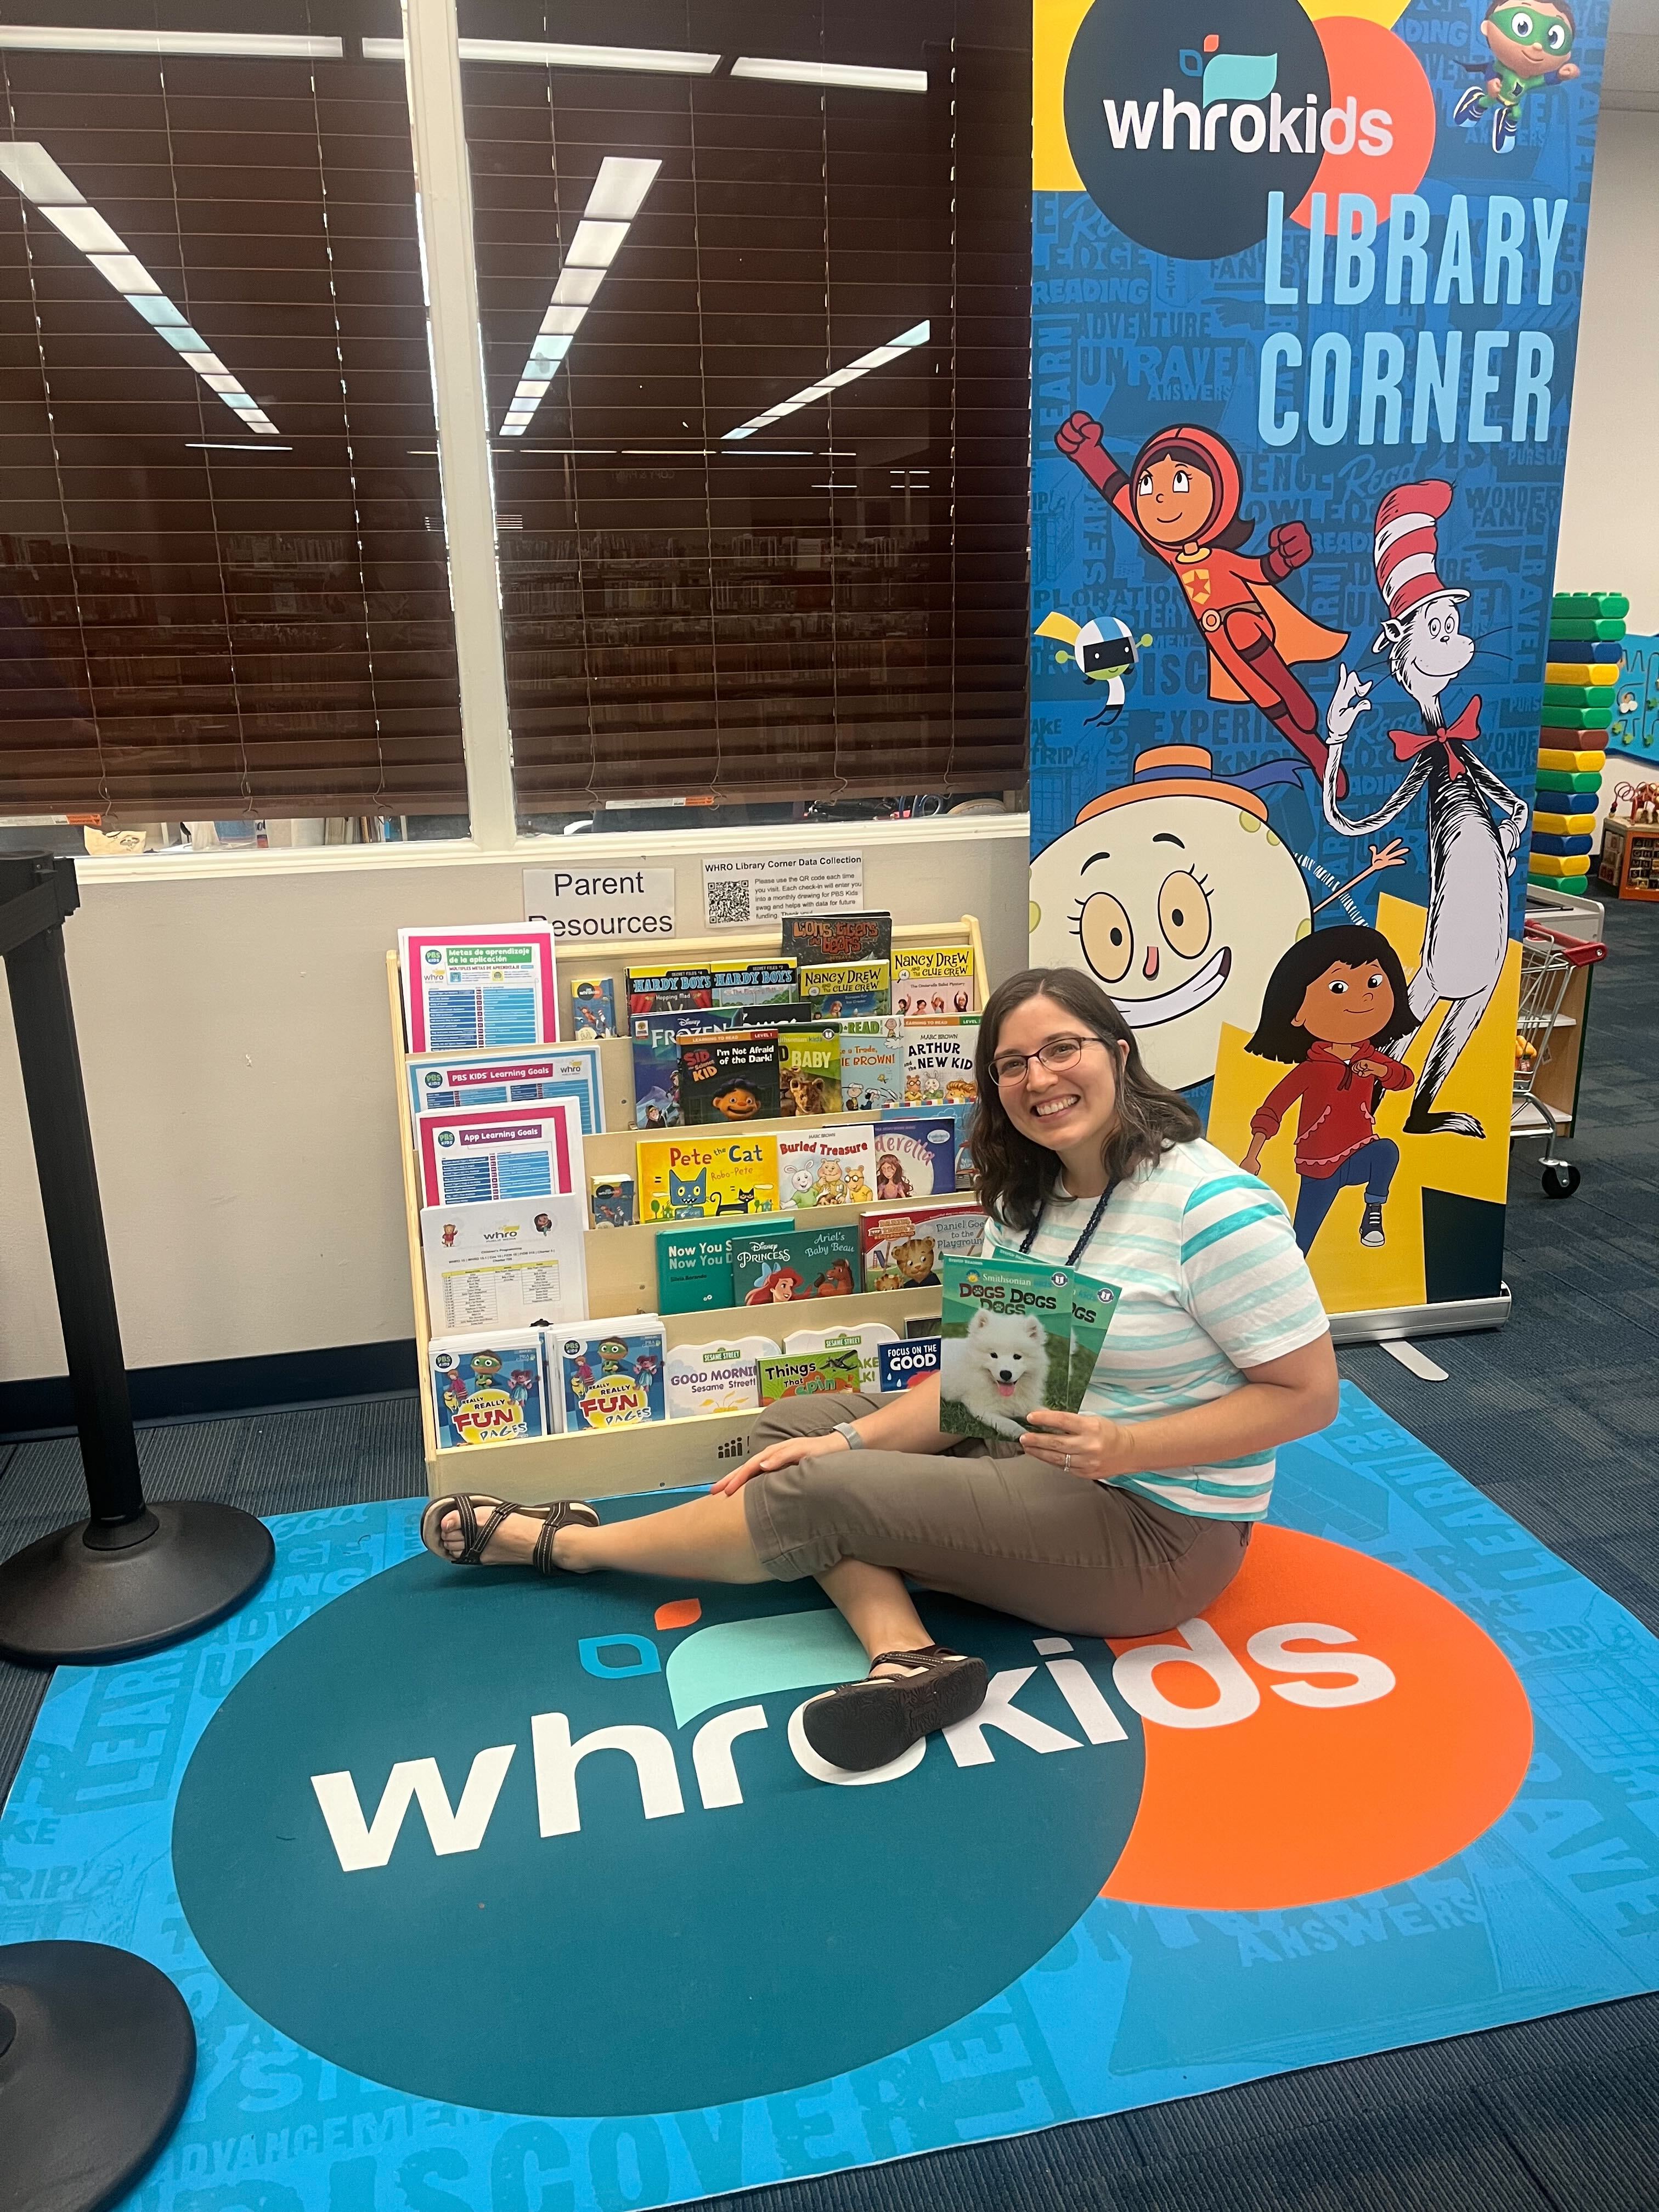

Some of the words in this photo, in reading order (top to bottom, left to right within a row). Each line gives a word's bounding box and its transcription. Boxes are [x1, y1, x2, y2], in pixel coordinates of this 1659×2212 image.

[1103, 88, 1393, 156] whrokids
[1264, 191, 1568, 306] LIBRARY
[1257, 331, 1555, 445] CORNER
[705, 864, 733, 872] WHRO
[736, 862, 765, 871] Library
[820, 856, 861, 865] Collection
[554, 871, 645, 897] Parent
[486, 947, 530, 957] aprendizaje
[936, 951, 969, 966] DREW
[470, 956, 507, 964] aplicación
[714, 973, 760, 987] HARDY
[763, 970, 792, 984] BOYS
[848, 968, 881, 984] DREW
[922, 968, 941, 977] CLUE
[944, 965, 968, 978] CREW
[634, 978, 678, 992] HARDY
[681, 976, 712, 990] BOYS
[855, 981, 879, 992] CREW
[749, 1046, 774, 1054] Afraid
[855, 1045, 878, 1054] Trade,
[909, 1042, 961, 1057] ARTHUR
[749, 1054, 772, 1063] Dark!
[792, 1051, 832, 1068] BABY
[853, 1053, 895, 1066] BROWN!
[918, 1057, 948, 1069] NEW
[951, 1057, 973, 1070] KID
[426, 1074, 441, 1082] PBS
[452, 1074, 467, 1082] PBS
[470, 1072, 487, 1080] KIDS
[490, 1069, 526, 1080] Learning
[528, 1067, 549, 1075] Goals
[692, 1066, 718, 1082] KID
[464, 1133, 479, 1143] App
[481, 1131, 515, 1141] Learning
[517, 1128, 538, 1136] Goals
[669, 1147, 712, 1167] Pete
[714, 1148, 726, 1156] the
[729, 1144, 764, 1162] Cat
[780, 1141, 816, 1155] Buried
[820, 1141, 868, 1155] Treasure
[711, 1166, 753, 1181] Robo-Pete
[936, 1220, 964, 1232] Daniel
[968, 1220, 984, 1228] Goe
[483, 1231, 517, 1240] whro
[814, 1232, 845, 1244] Ariel's
[668, 1245, 695, 1257] Now
[699, 1243, 722, 1254] You
[749, 1242, 777, 1251] Disney
[805, 1244, 829, 1257] Baby
[831, 1242, 855, 1253] Beau
[669, 1257, 696, 1270] Now
[700, 1255, 723, 1266] You
[737, 1249, 791, 1268] PRINCESS
[983, 1273, 1031, 1286] Smithsonian
[960, 1283, 1005, 1299] DOGS
[1010, 1288, 1057, 1310] DOGS
[980, 1297, 1026, 1315] DOGS
[826, 1339, 844, 1348] SESAME
[844, 1337, 861, 1346] STREET
[704, 1352, 723, 1362] SESAME
[723, 1351, 740, 1359] STREET
[888, 1347, 910, 1357] FOCUS
[912, 1346, 922, 1354] ON
[923, 1344, 937, 1353] THE
[890, 1353, 936, 1371] GOOD
[670, 1370, 707, 1386] GOOD
[783, 1378, 803, 1387] That
[601, 1385, 630, 1395] REALLY
[691, 1383, 724, 1393] Sesame
[729, 1379, 756, 1389] Street!
[474, 1400, 505, 1410] REALLY
[580, 1394, 638, 1417] FUN
[453, 1409, 514, 1432] FUN
[606, 1408, 651, 1426] PAGES
[480, 1423, 527, 1441] PAGES
